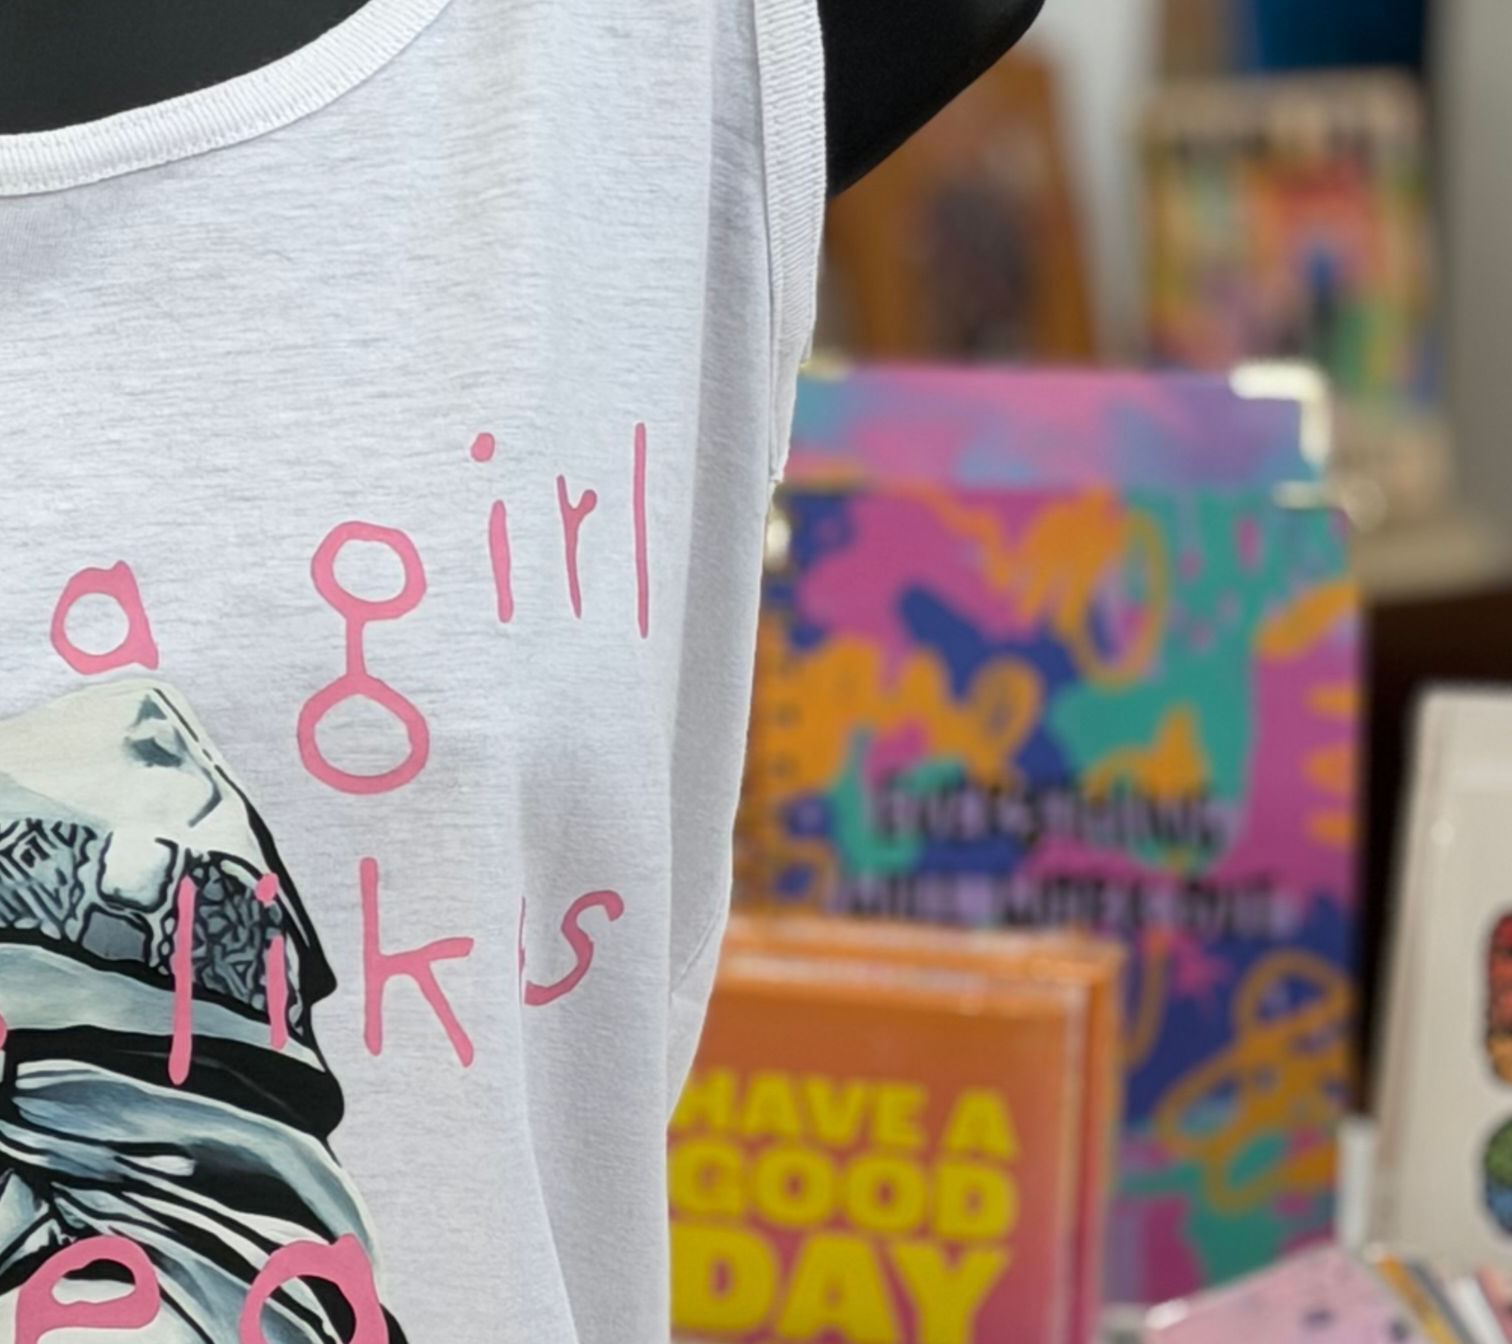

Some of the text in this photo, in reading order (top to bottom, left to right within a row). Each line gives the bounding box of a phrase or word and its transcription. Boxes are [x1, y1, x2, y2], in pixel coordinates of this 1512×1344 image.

[50, 561, 159, 676] a
[296, 423, 648, 796] girl
[167, 857, 625, 1086] liks
[668, 1138, 1017, 1240] GOOD
[670, 1066, 1021, 1158] HAVE A
